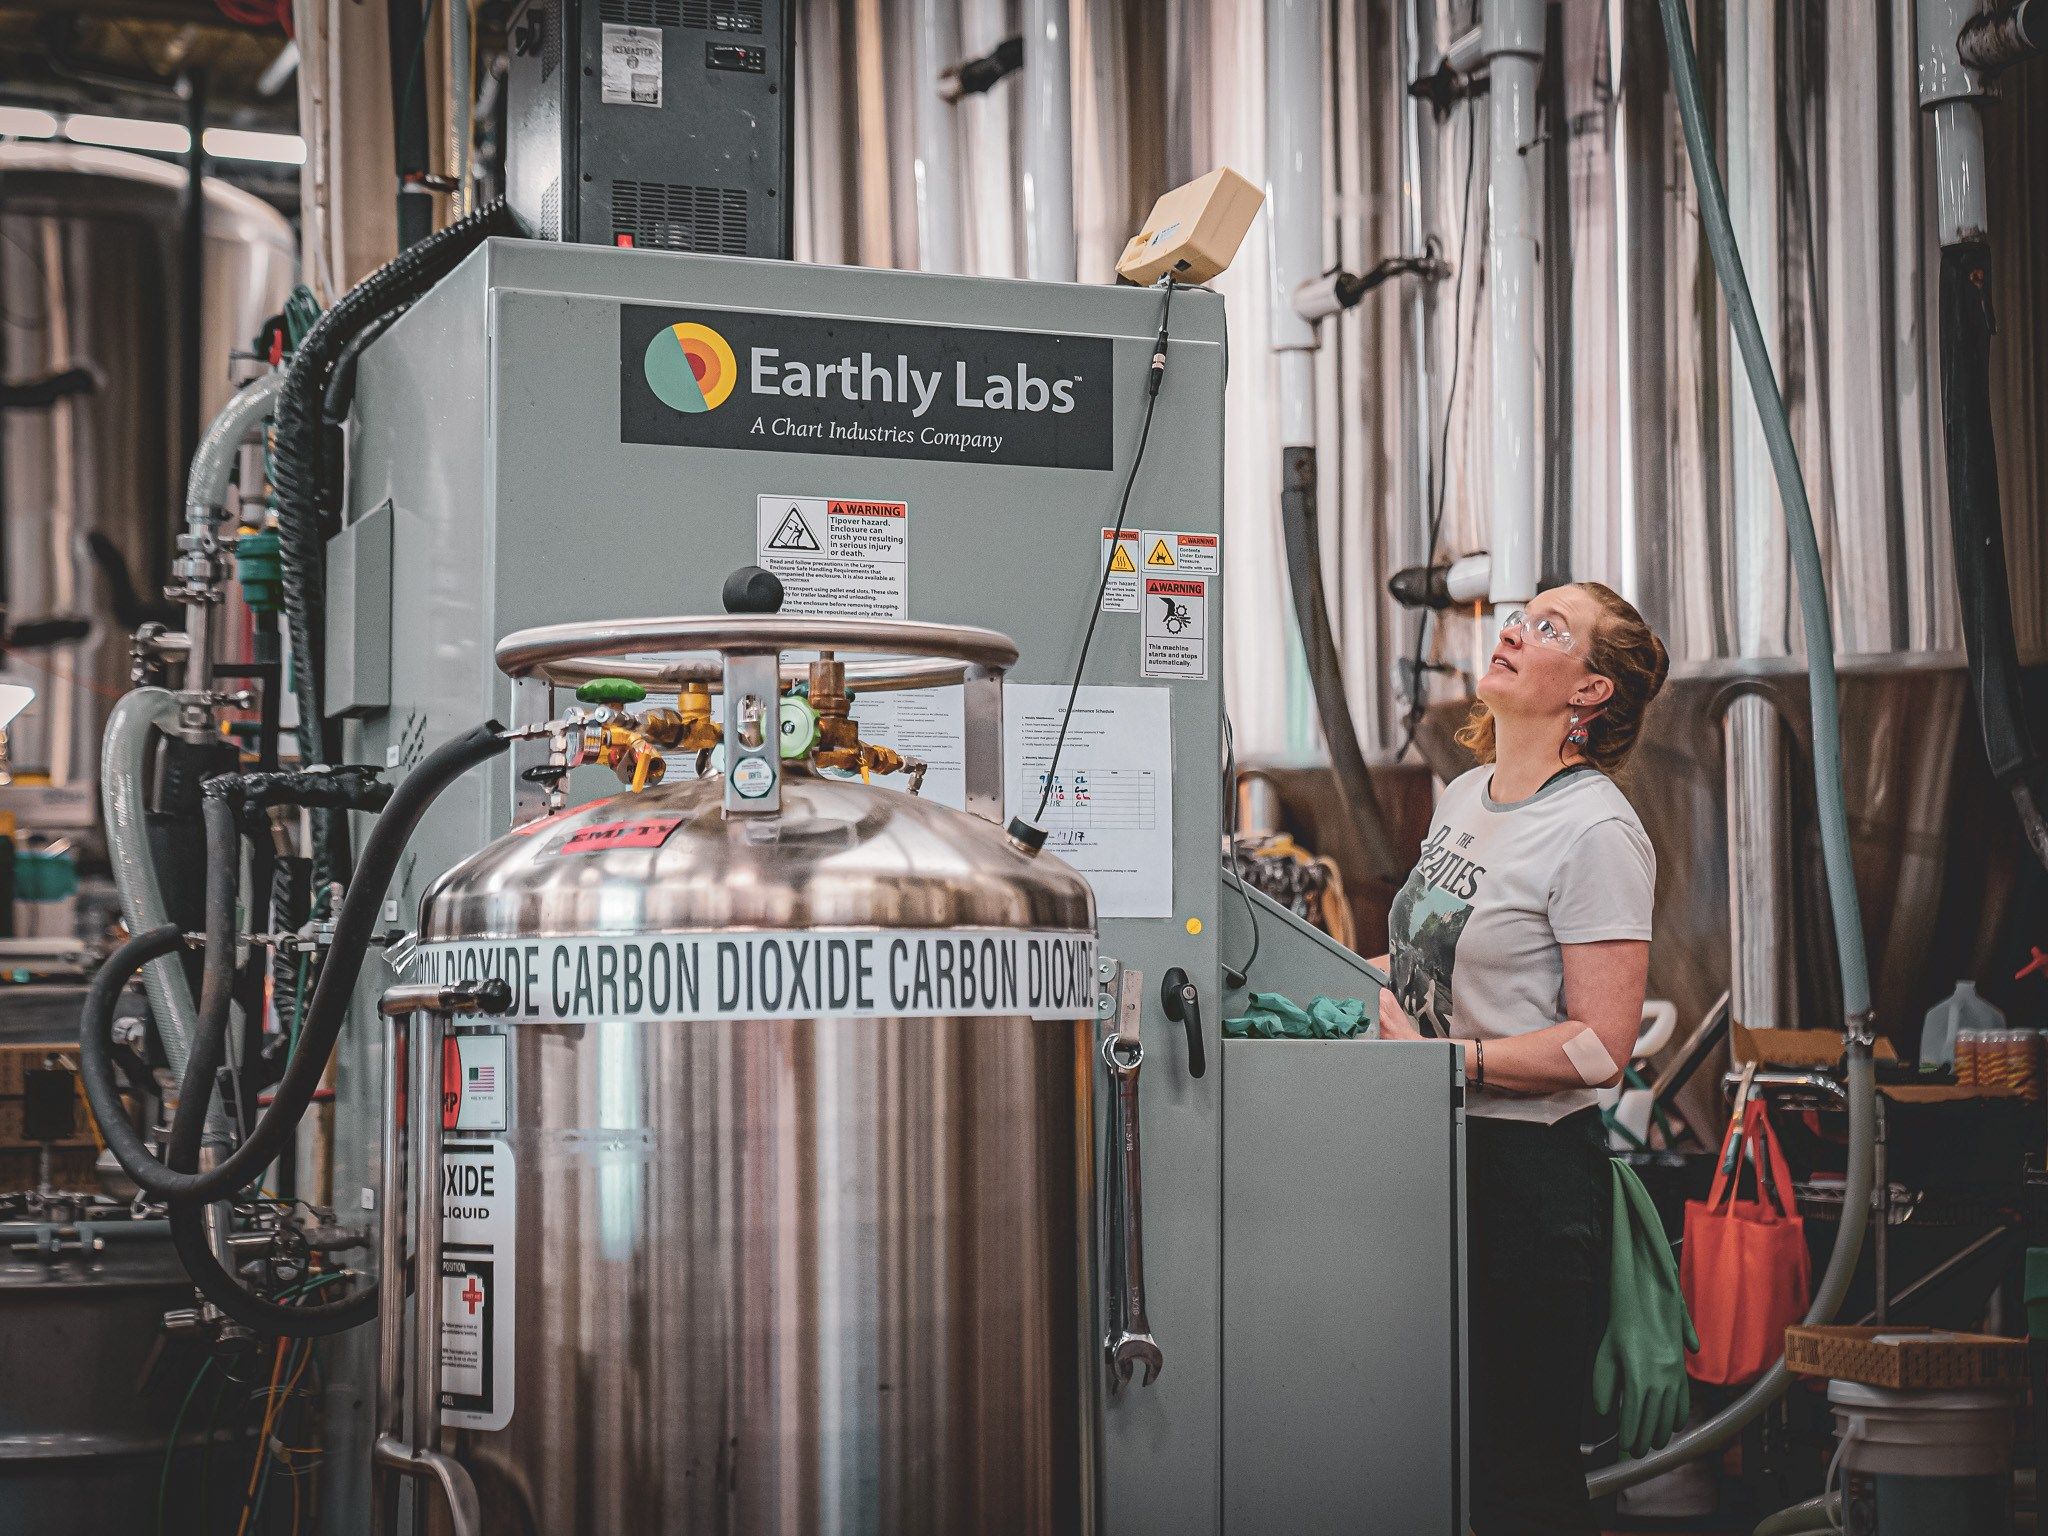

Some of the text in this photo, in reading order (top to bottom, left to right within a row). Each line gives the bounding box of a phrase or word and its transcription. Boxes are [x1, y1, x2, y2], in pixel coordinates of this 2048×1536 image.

[751, 346, 943, 418] Earthly
[750, 417, 1003, 453] A Chart Industries Company
[846, 504, 901, 516] WARNING
[830, 516, 891, 527] Tipover hazard.
[830, 525, 868, 534] Enclosure
[869, 535, 904, 544] resulting
[1113, 532, 1137, 540] RNING
[868, 542, 892, 552] injury
[840, 550, 866, 558] death.
[1158, 582, 1201, 594] WARNING
[1456, 832, 1474, 849] THE
[1420, 825, 1486, 900] BEATLES
[552, 942, 699, 1018] CARBON
[718, 938, 874, 1014] DIOXIDE
[890, 938, 1017, 1010] CARBON
[442, 1165, 494, 1197] XIDE
